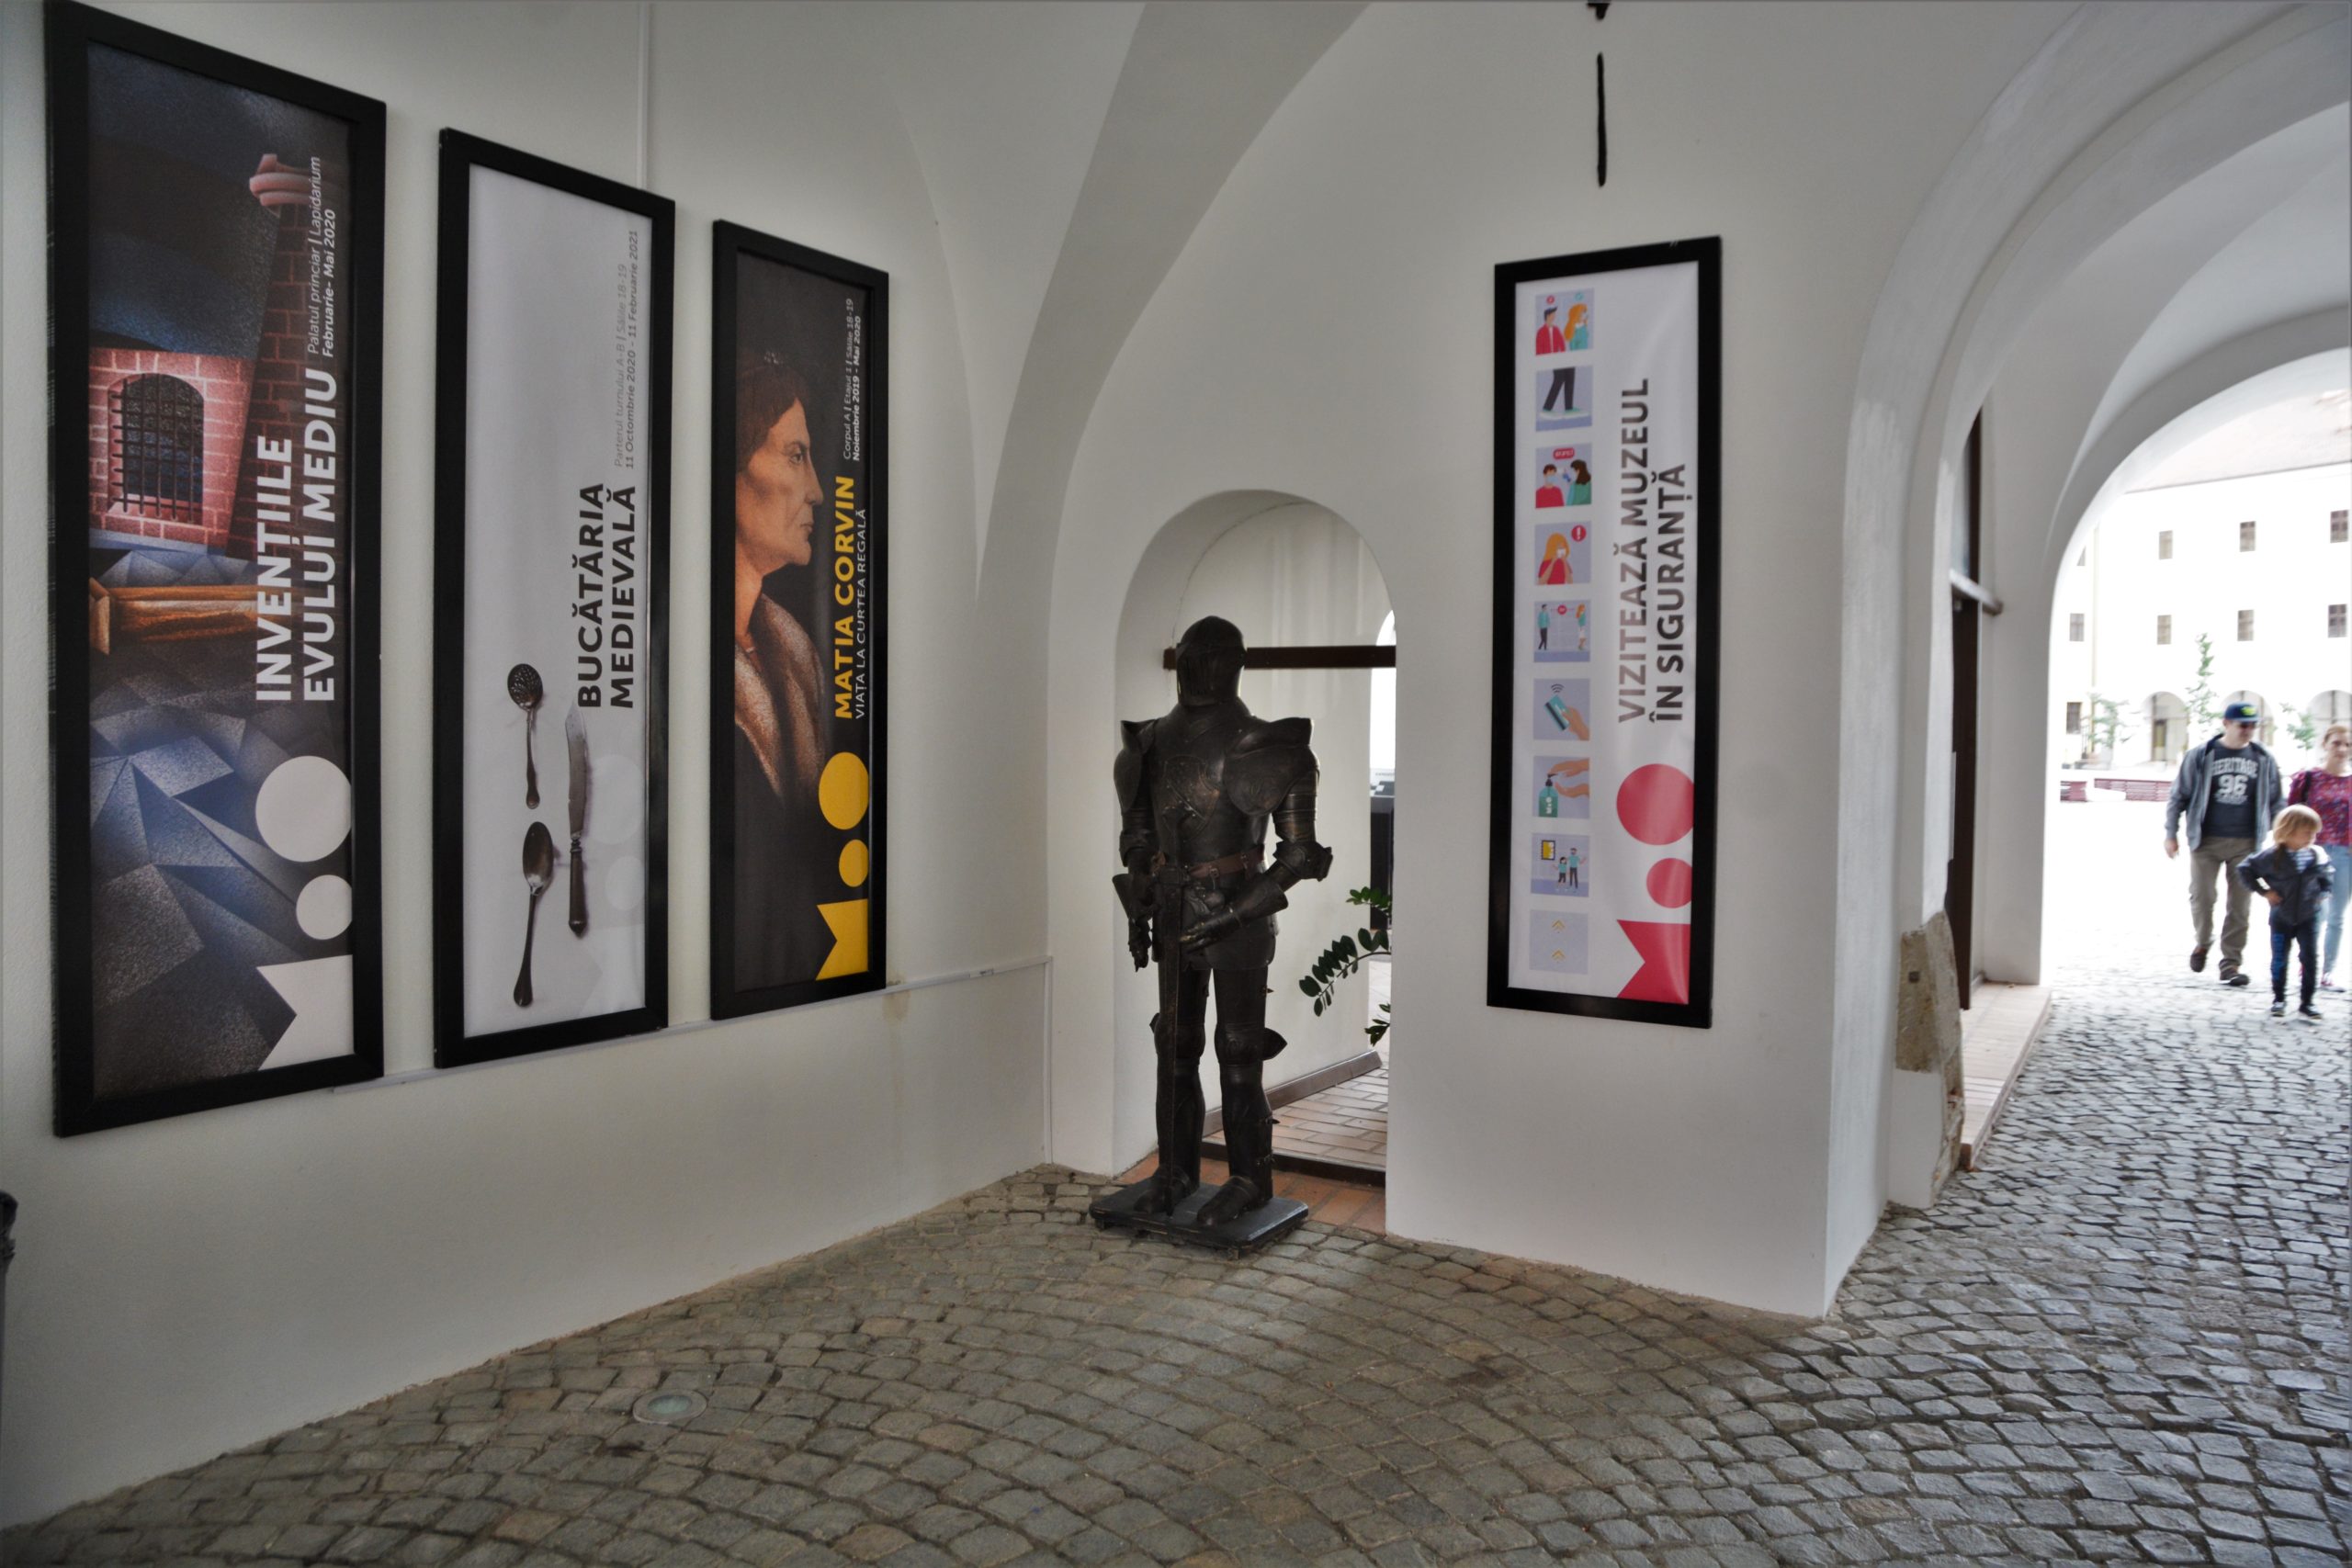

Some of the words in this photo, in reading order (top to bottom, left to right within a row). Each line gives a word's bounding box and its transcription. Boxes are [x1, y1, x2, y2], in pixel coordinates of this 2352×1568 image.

[309, 157, 322, 235] Lapidarium
[324, 209, 335, 248] 2020
[628, 231, 638, 260] 2021
[310, 247, 322, 302] princiar
[323, 250, 334, 277] Mai
[618, 265, 627, 299] 18-19
[628, 264, 638, 321] Februarie
[308, 307, 320, 354] Palatul
[322, 281, 334, 357] Februarie-
[628, 325, 637, 337] 11
[616, 344, 625, 367] A-B
[627, 350, 636, 382] 2020
[615, 369, 624, 416] turnului
[844, 376, 853, 404] Etajul
[626, 385, 635, 452] Octombrie
[843, 413, 851, 422] A
[843, 423, 852, 459] Corpul
[302, 368, 336, 523] MEDIU
[614, 421, 623, 468] Parterul
[625, 457, 634, 469] 11
[1620, 378, 1648, 526] MUZEUL
[835, 476, 854, 606] CORVIN
[854, 509, 866, 572] REGALĂ
[255, 437, 300, 702] INVENȚIILE
[1651, 464, 1692, 673] SIGURANȚĂ
[302, 536, 335, 702] EVULUI
[572, 483, 605, 708] BUCĂTĂRIA
[606, 486, 636, 709] MEDIEVALĂ
[856, 579, 866, 644] CURTEA
[1612, 537, 1647, 723] VIZITEAZĂ
[835, 616, 854, 719] MATIA
[856, 649, 866, 668] LA
[854, 673, 867, 719] VIAȚA
[1649, 685, 1683, 722] ÎN
[2218, 774, 2248, 795] 96
